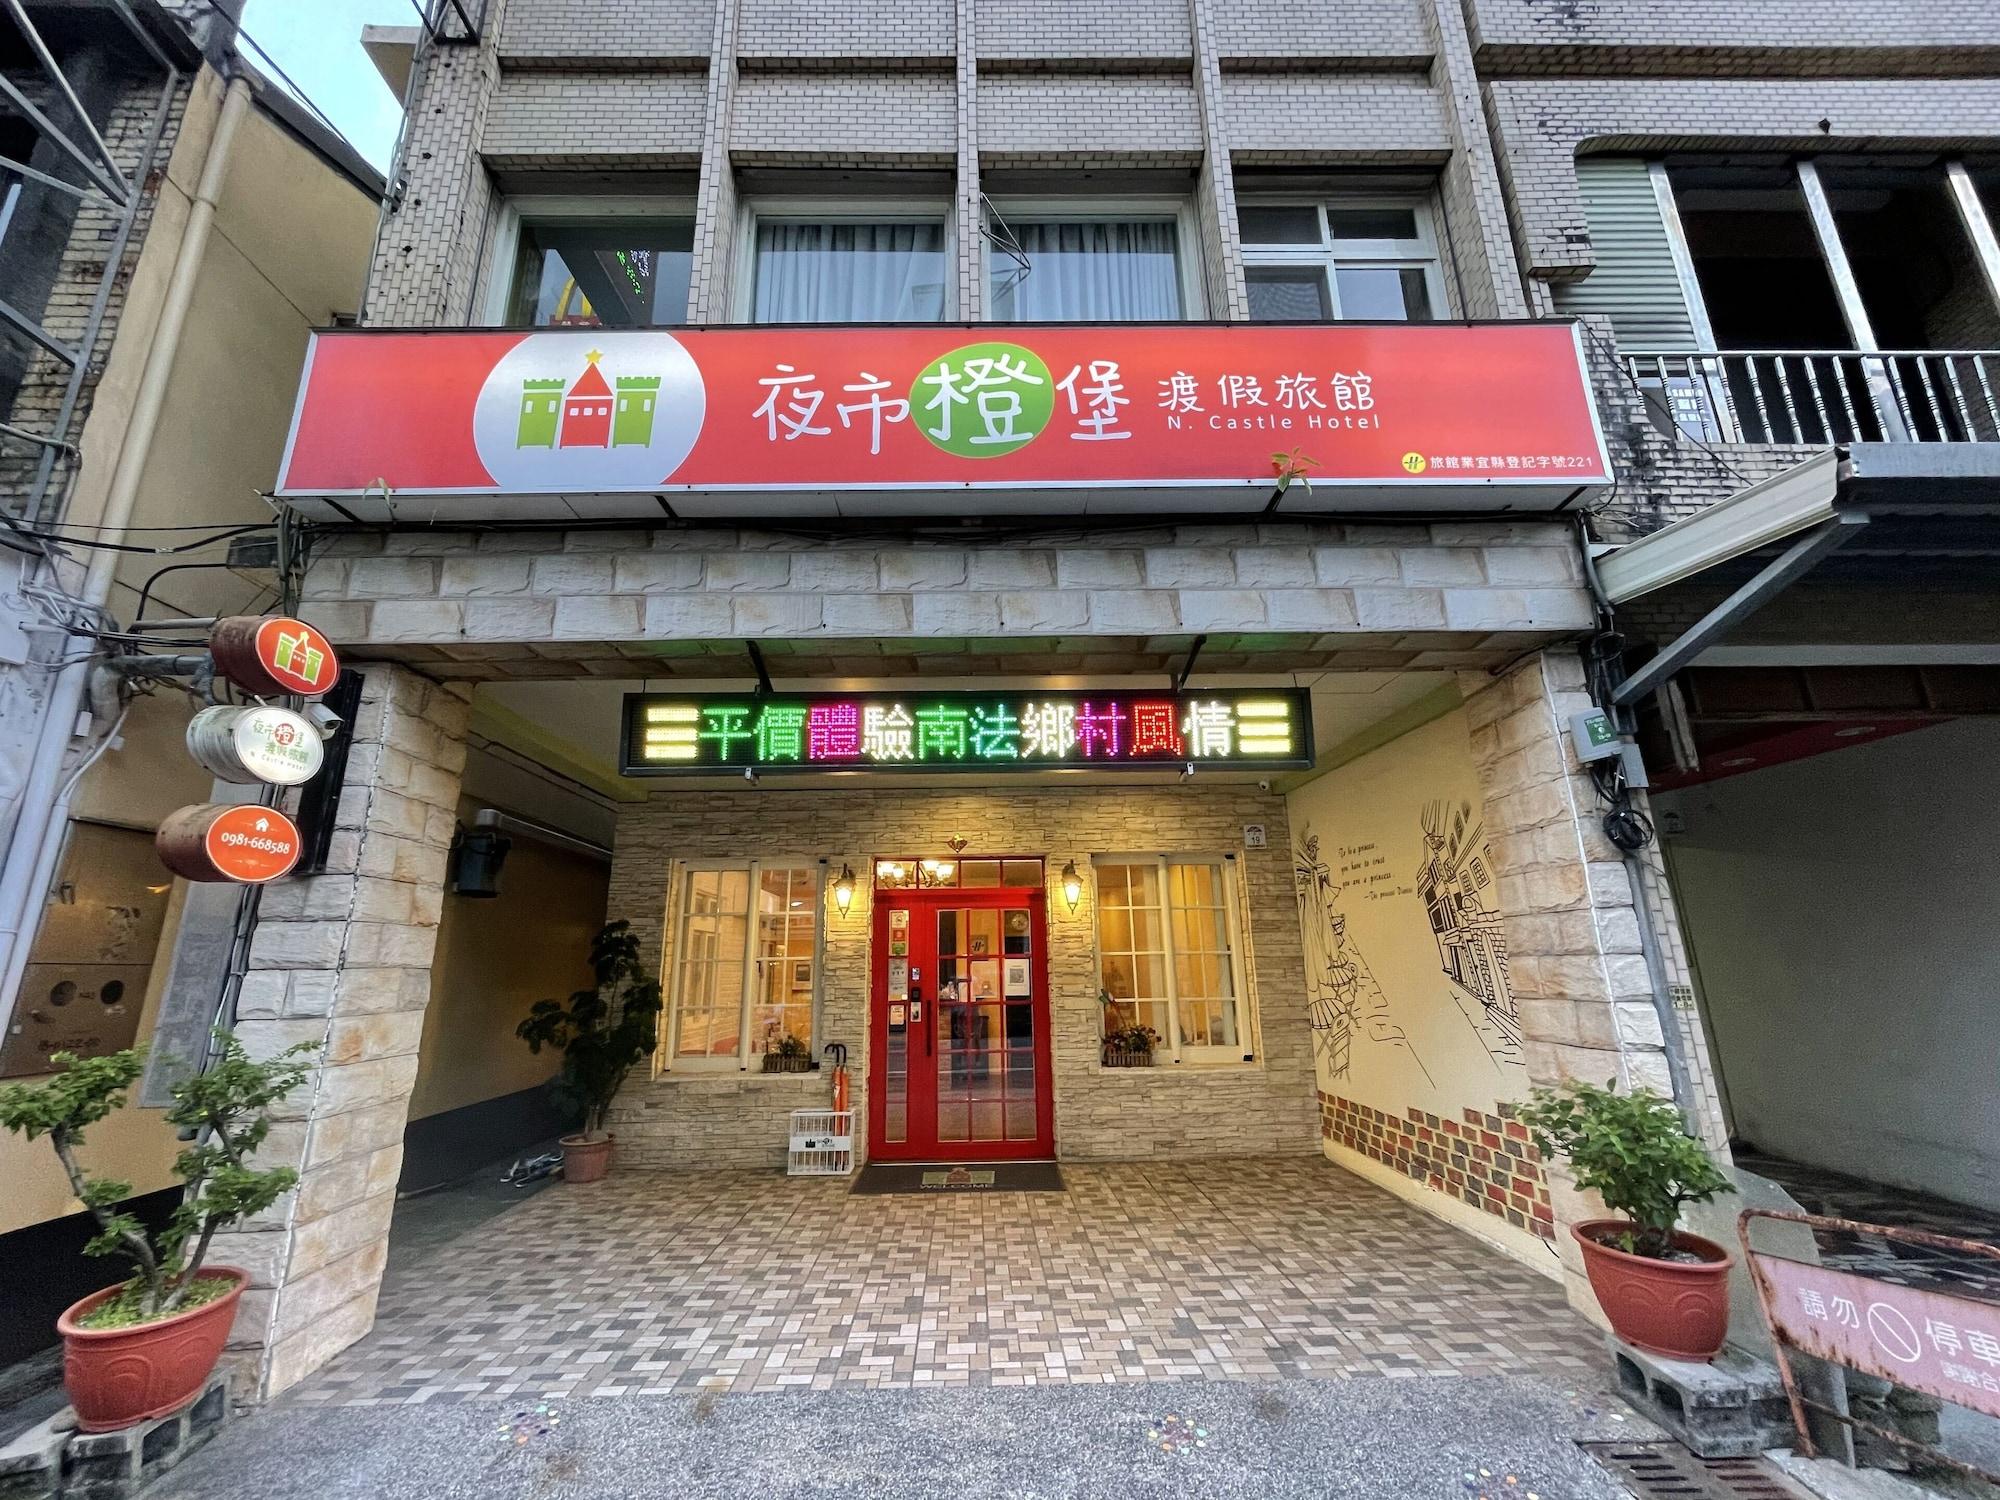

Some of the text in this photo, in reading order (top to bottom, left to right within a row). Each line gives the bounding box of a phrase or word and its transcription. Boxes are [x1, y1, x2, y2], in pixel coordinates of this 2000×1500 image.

[752, 353, 1375, 455] 夜市橙堡 渡假旅館
[1167, 414, 1379, 430] N. Castle Hotel
[1430, 456, 1593, 470] 旅館業宜縣登記字號221
[699, 701, 1236, 761] 平價體驗南法鄉村風情
[221, 832, 291, 854] 0981-668588
[1799, 1287, 2000, 1367] 請勿 停車
